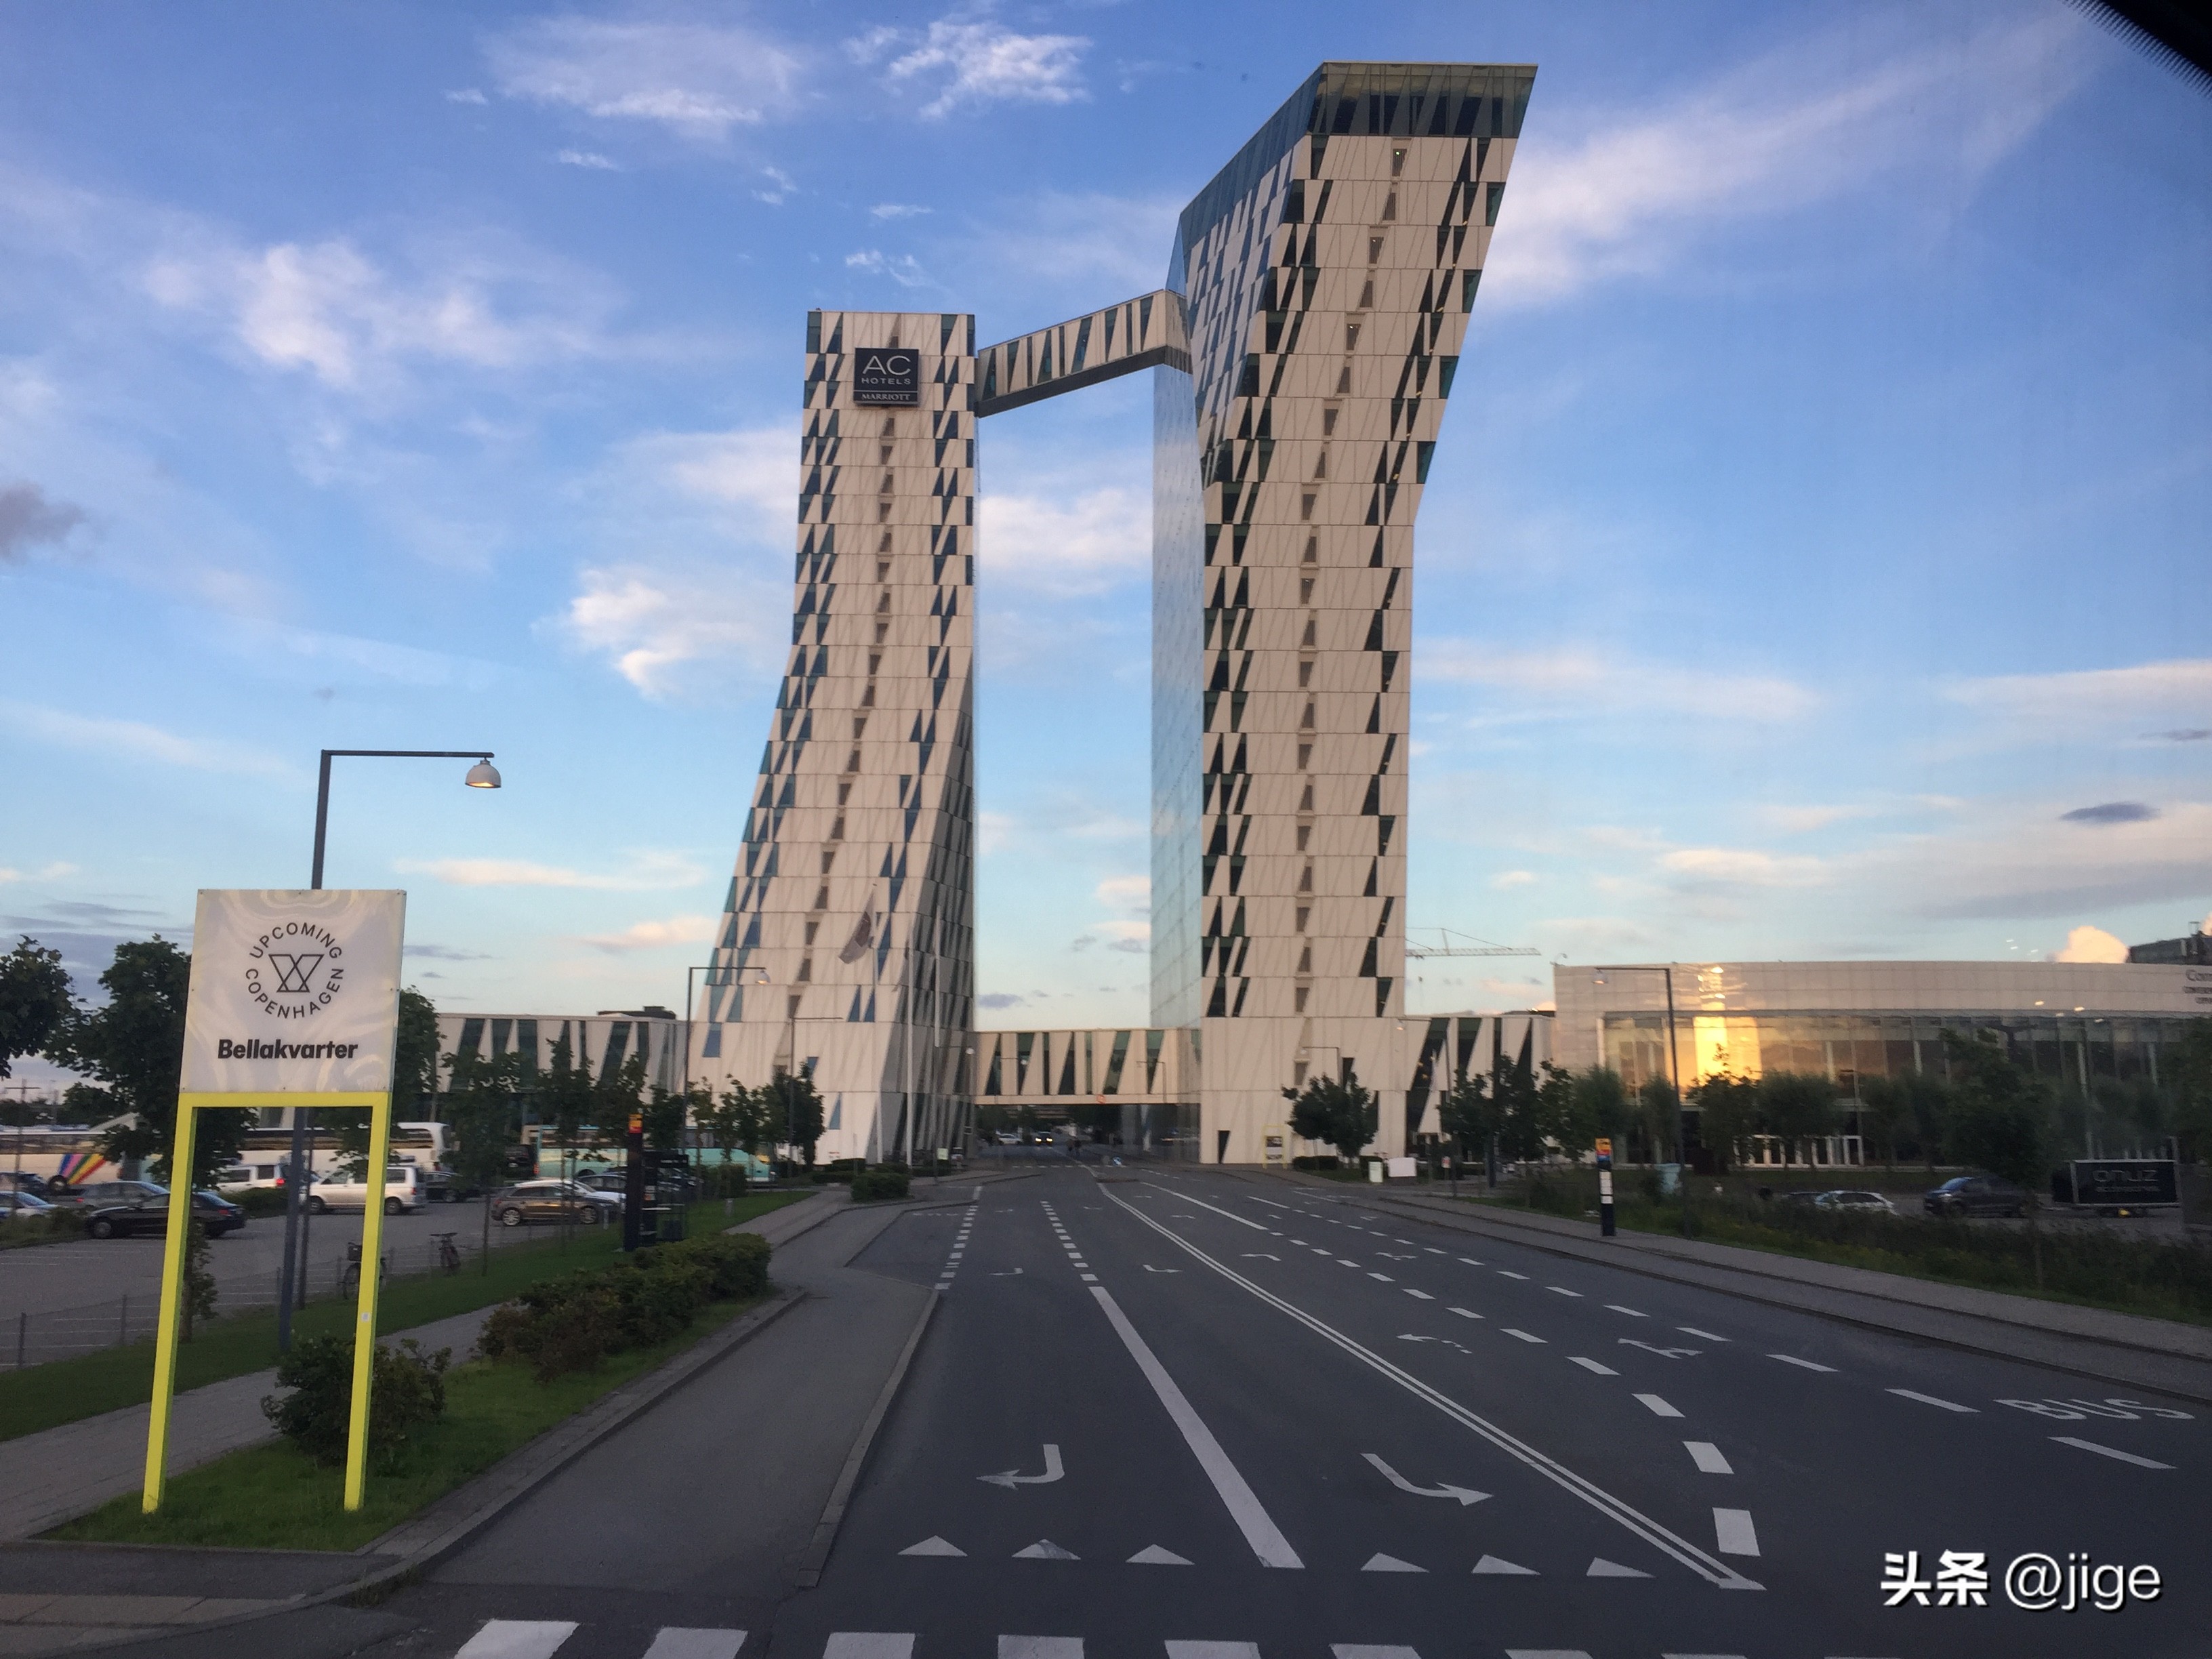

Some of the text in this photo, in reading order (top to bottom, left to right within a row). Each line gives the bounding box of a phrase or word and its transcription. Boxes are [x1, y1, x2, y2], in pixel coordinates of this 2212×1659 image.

[862, 355, 911, 375] AC
[249, 922, 342, 960] UPCOMING
[245, 968, 344, 1019] COPENHAGEN
[218, 1039, 359, 1059] Bellakvarter
[1992, 1398, 2195, 1420] BUS
